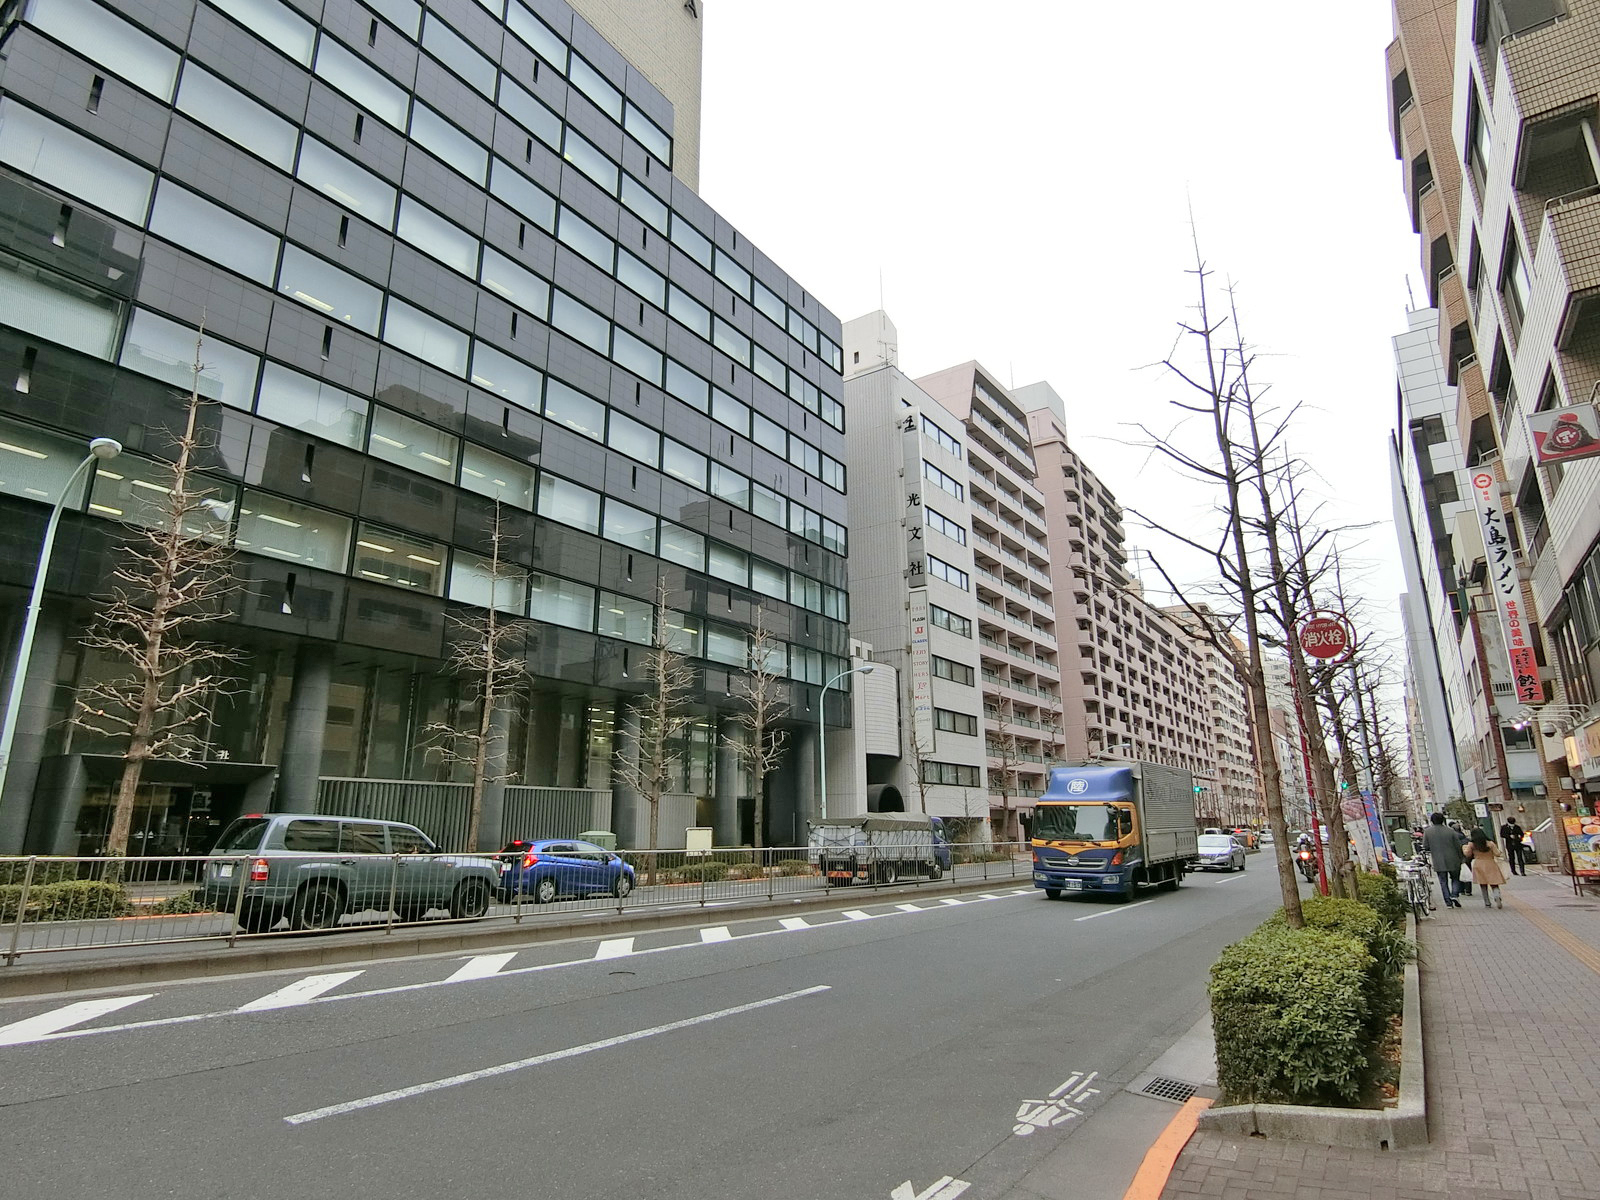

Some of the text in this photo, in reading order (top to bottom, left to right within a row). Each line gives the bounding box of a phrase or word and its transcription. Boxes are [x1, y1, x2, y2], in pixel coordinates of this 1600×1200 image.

[907, 493, 924, 577] 光文社
[1484, 507, 1515, 594] 大島ラーメン
[1303, 629, 1344, 647] 消火栓
[1517, 674, 1540, 700] 餃子
